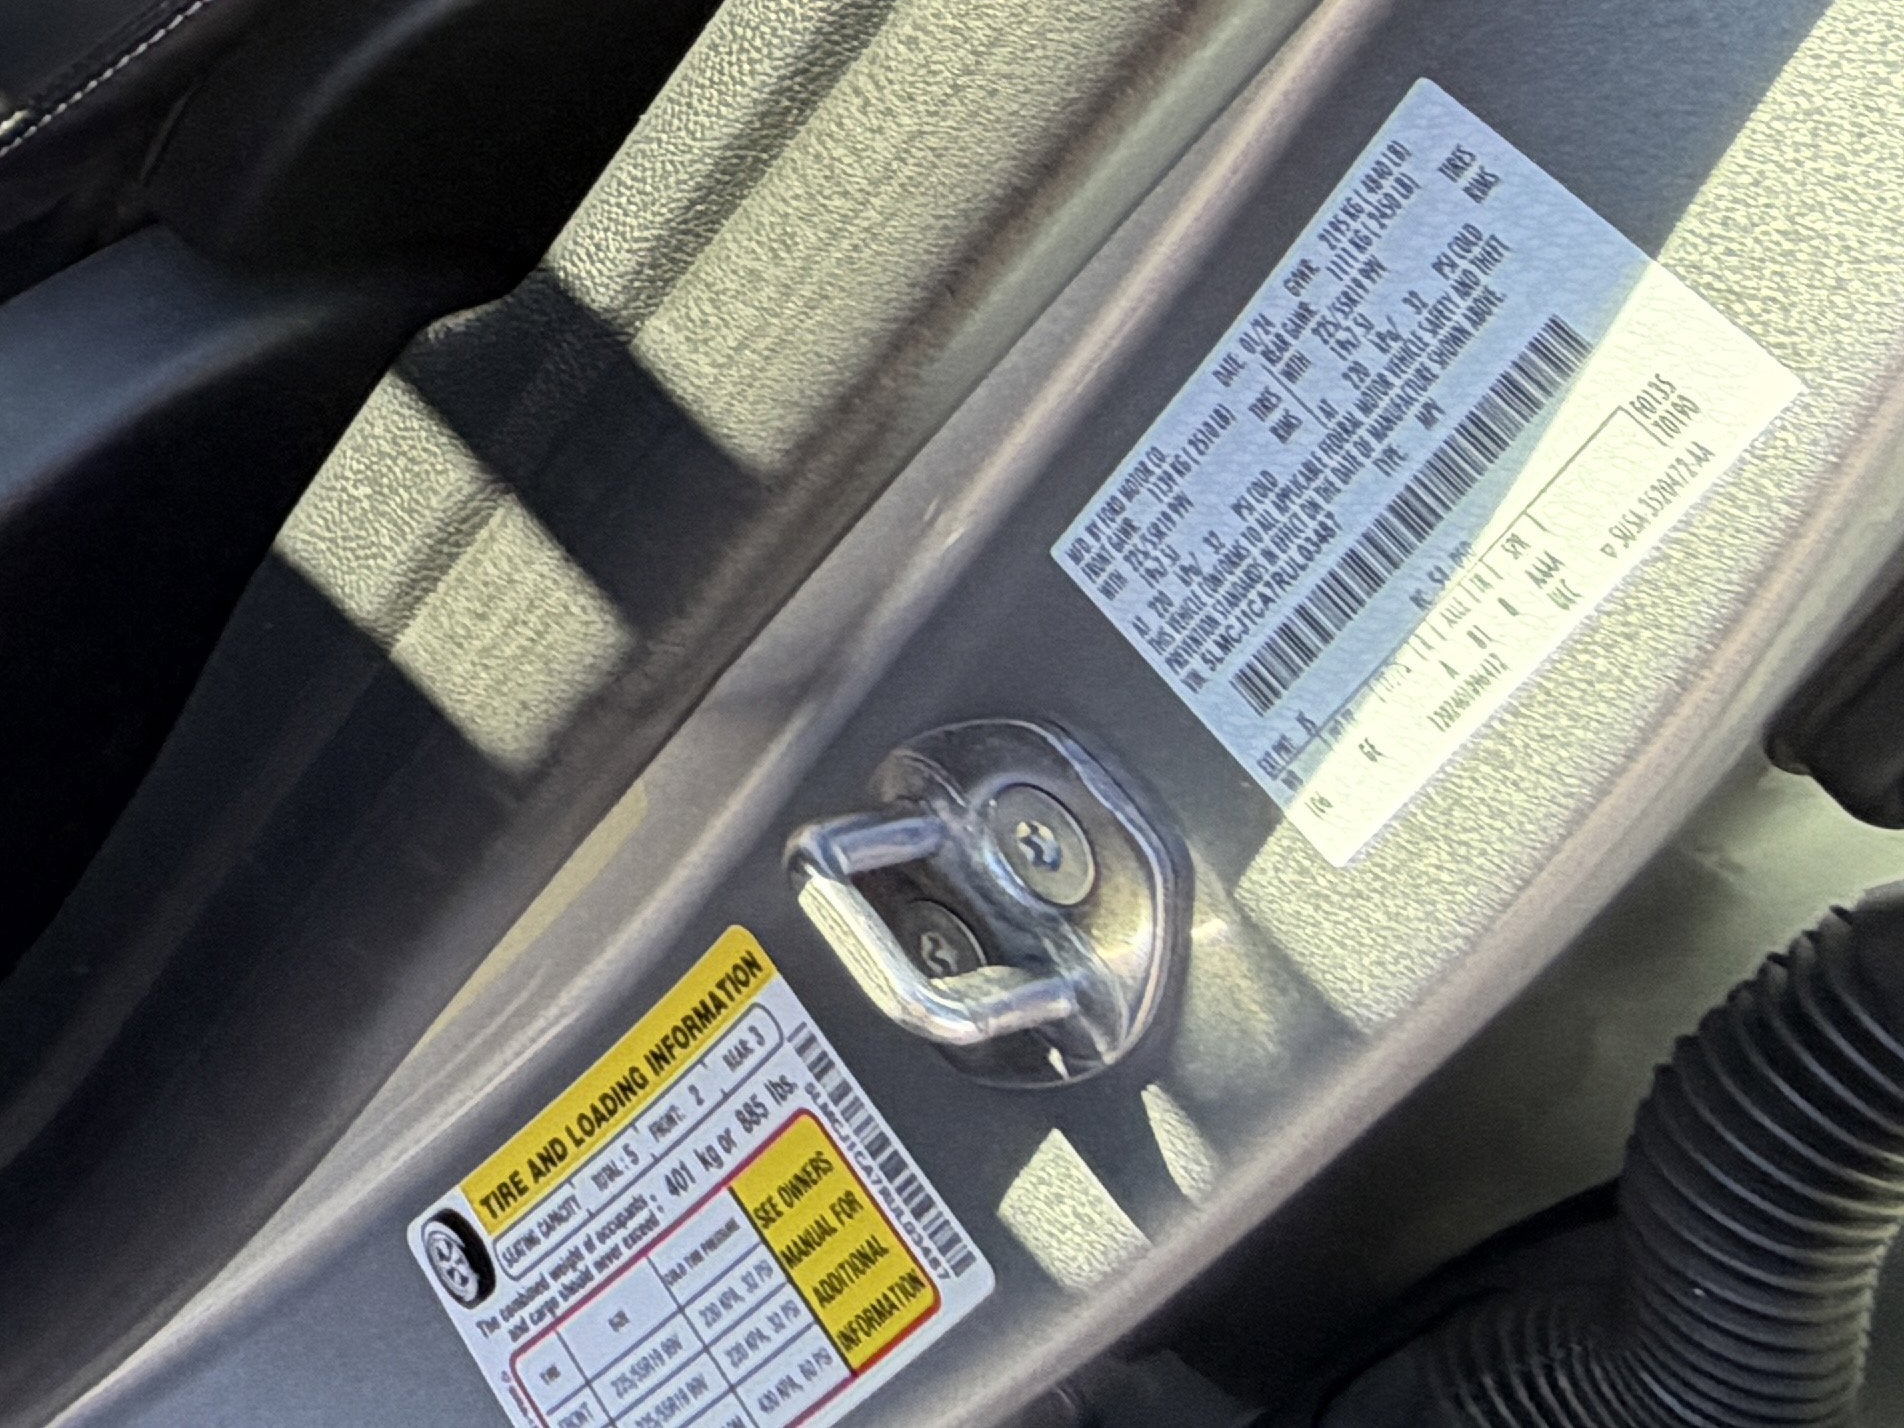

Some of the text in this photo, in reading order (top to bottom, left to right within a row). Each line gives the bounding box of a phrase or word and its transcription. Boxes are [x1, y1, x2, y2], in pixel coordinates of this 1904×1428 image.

[1462, 165, 1500, 203] RIMS
[1279, 350, 1311, 384] WITH
[1437, 144, 1475, 182] TIRES
[1446, 222, 1483, 260] COLD
[1166, 589, 1207, 634] VEHICLE
[1197, 539, 1250, 598] CONFORMS
[1239, 525, 1264, 547] TO
[1254, 508, 1280, 534] ALL
[1271, 451, 1327, 514] APPLICABLE
[1317, 411, 1363, 458] FEDERAL
[1353, 372, 1394, 417] MOTOR
[1383, 330, 1430, 379] VEHICLE
[1416, 291, 1459, 338] SAFETY
[1450, 268, 1480, 300] AND
[1468, 233, 1510, 275] THEFT
[1095, 494, 1126, 528] FORD
[1118, 460, 1155, 502] MOTOR
[1164, 614, 1220, 674] PREVENTION
[1211, 558, 1268, 619] STANDARDS
[1269, 511, 1308, 554] EFFECT
[1298, 498, 1324, 521] ON
[1312, 476, 1342, 504] THE
[1329, 449, 1364, 485] DATE
[1351, 434, 1375, 459] OF
[1366, 362, 1438, 442] MANUFACTURE
[1427, 325, 1472, 369] SHOWN
[1245, 469, 1278, 504] COLD
[1080, 543, 1114, 583] FRONT
[1097, 569, 1127, 601] WITH
[479, 951, 762, 1219] TIRE AND LOADING INFORMATION
[621, 1142, 639, 1165] 5
[687, 1083, 705, 1106] 2
[747, 1024, 765, 1047] 3
[507, 1316, 530, 1343] and
[557, 1265, 594, 1302] should
[592, 1243, 622, 1273] never
[663, 1160, 696, 1196] 401
[692, 1144, 724, 1171] kg
[716, 1126, 737, 1154] or
[734, 1093, 769, 1133] 885
[752, 1195, 784, 1229] SEE
[780, 1189, 863, 1268] MANUAL FOR
[498, 1273, 550, 1322] combined
[548, 1245, 584, 1285] weight
[582, 1233, 597, 1254] of
[812, 1235, 889, 1307] ADDITIONAL
[837, 1269, 925, 1351] INFORMATION
